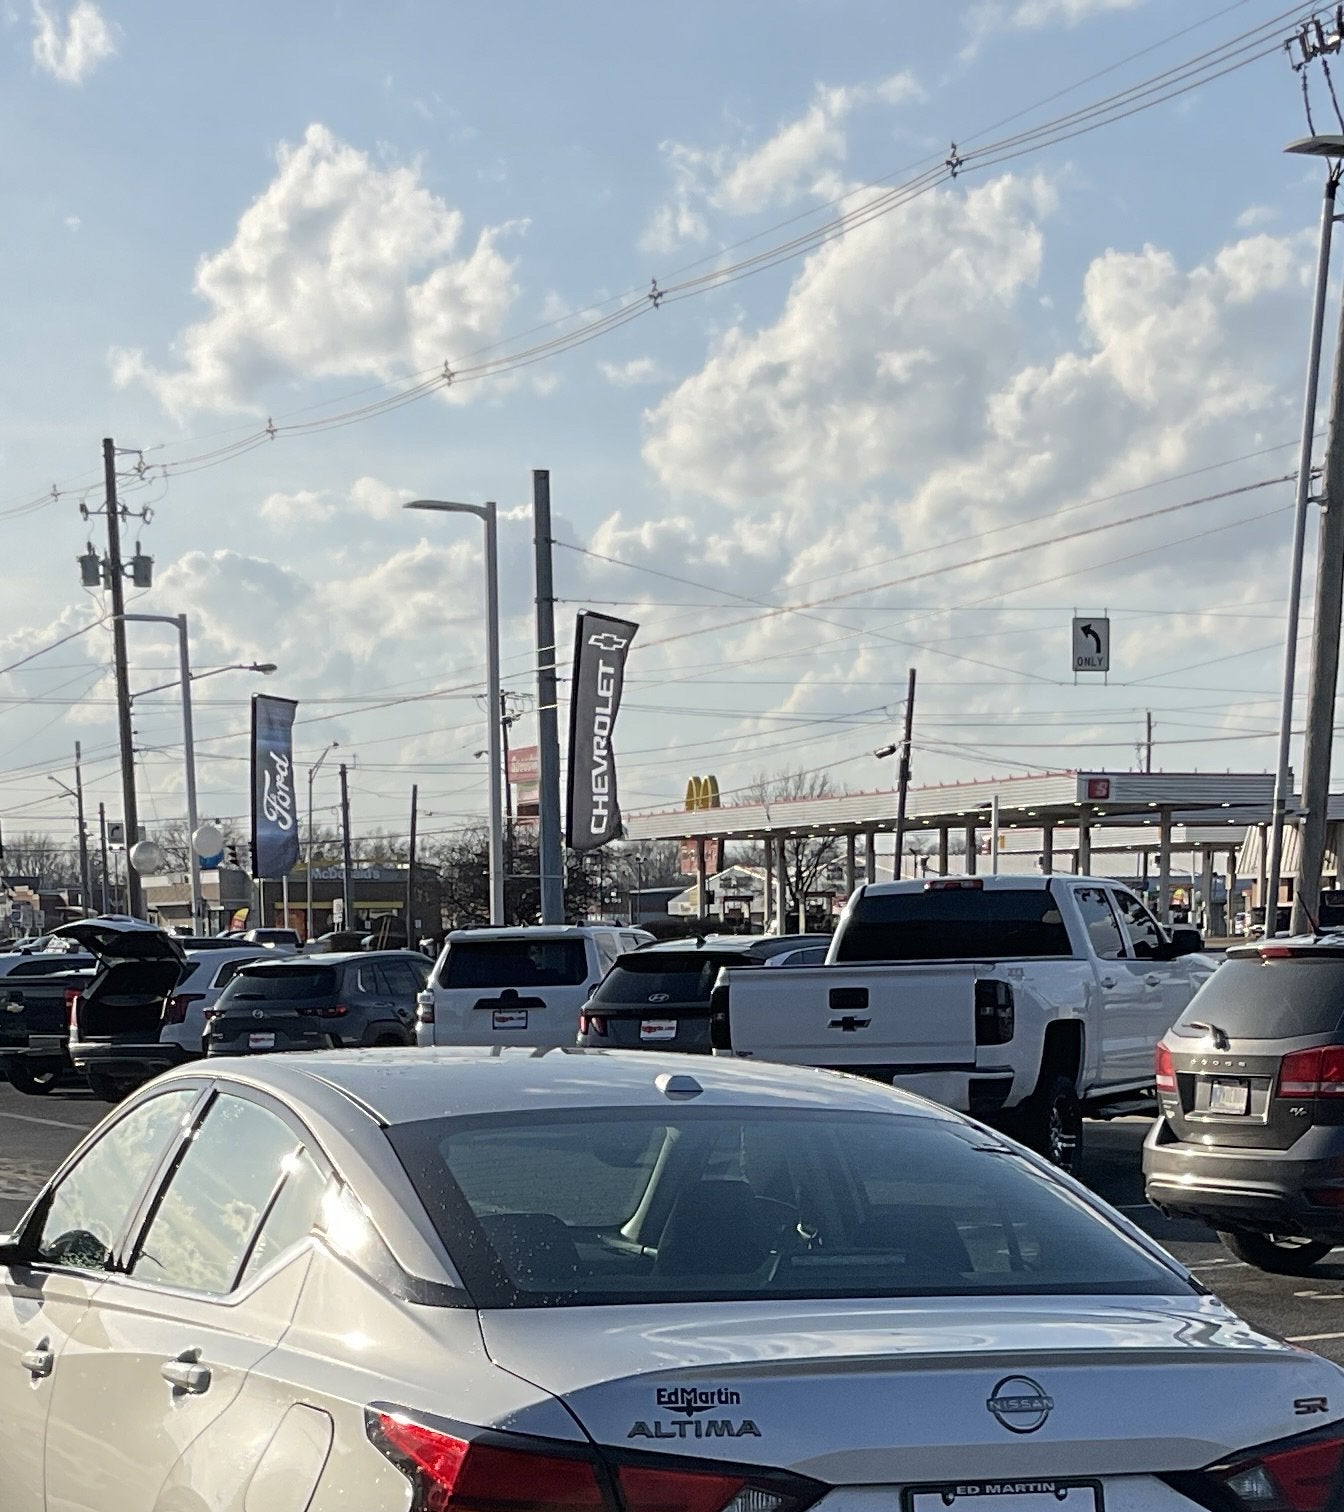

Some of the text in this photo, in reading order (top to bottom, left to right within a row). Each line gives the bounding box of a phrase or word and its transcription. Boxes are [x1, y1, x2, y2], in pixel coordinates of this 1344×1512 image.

[1077, 655, 1104, 668] ONLY
[590, 658, 615, 836] CHEVROLET
[263, 750, 293, 831] Ford
[656, 1387, 741, 1406] EdMartin
[989, 1399, 1053, 1410] NISSAN
[1294, 1396, 1330, 1415] SR
[627, 1419, 762, 1439] ALTIMA
[956, 1482, 1056, 1495] ED MARTIN
